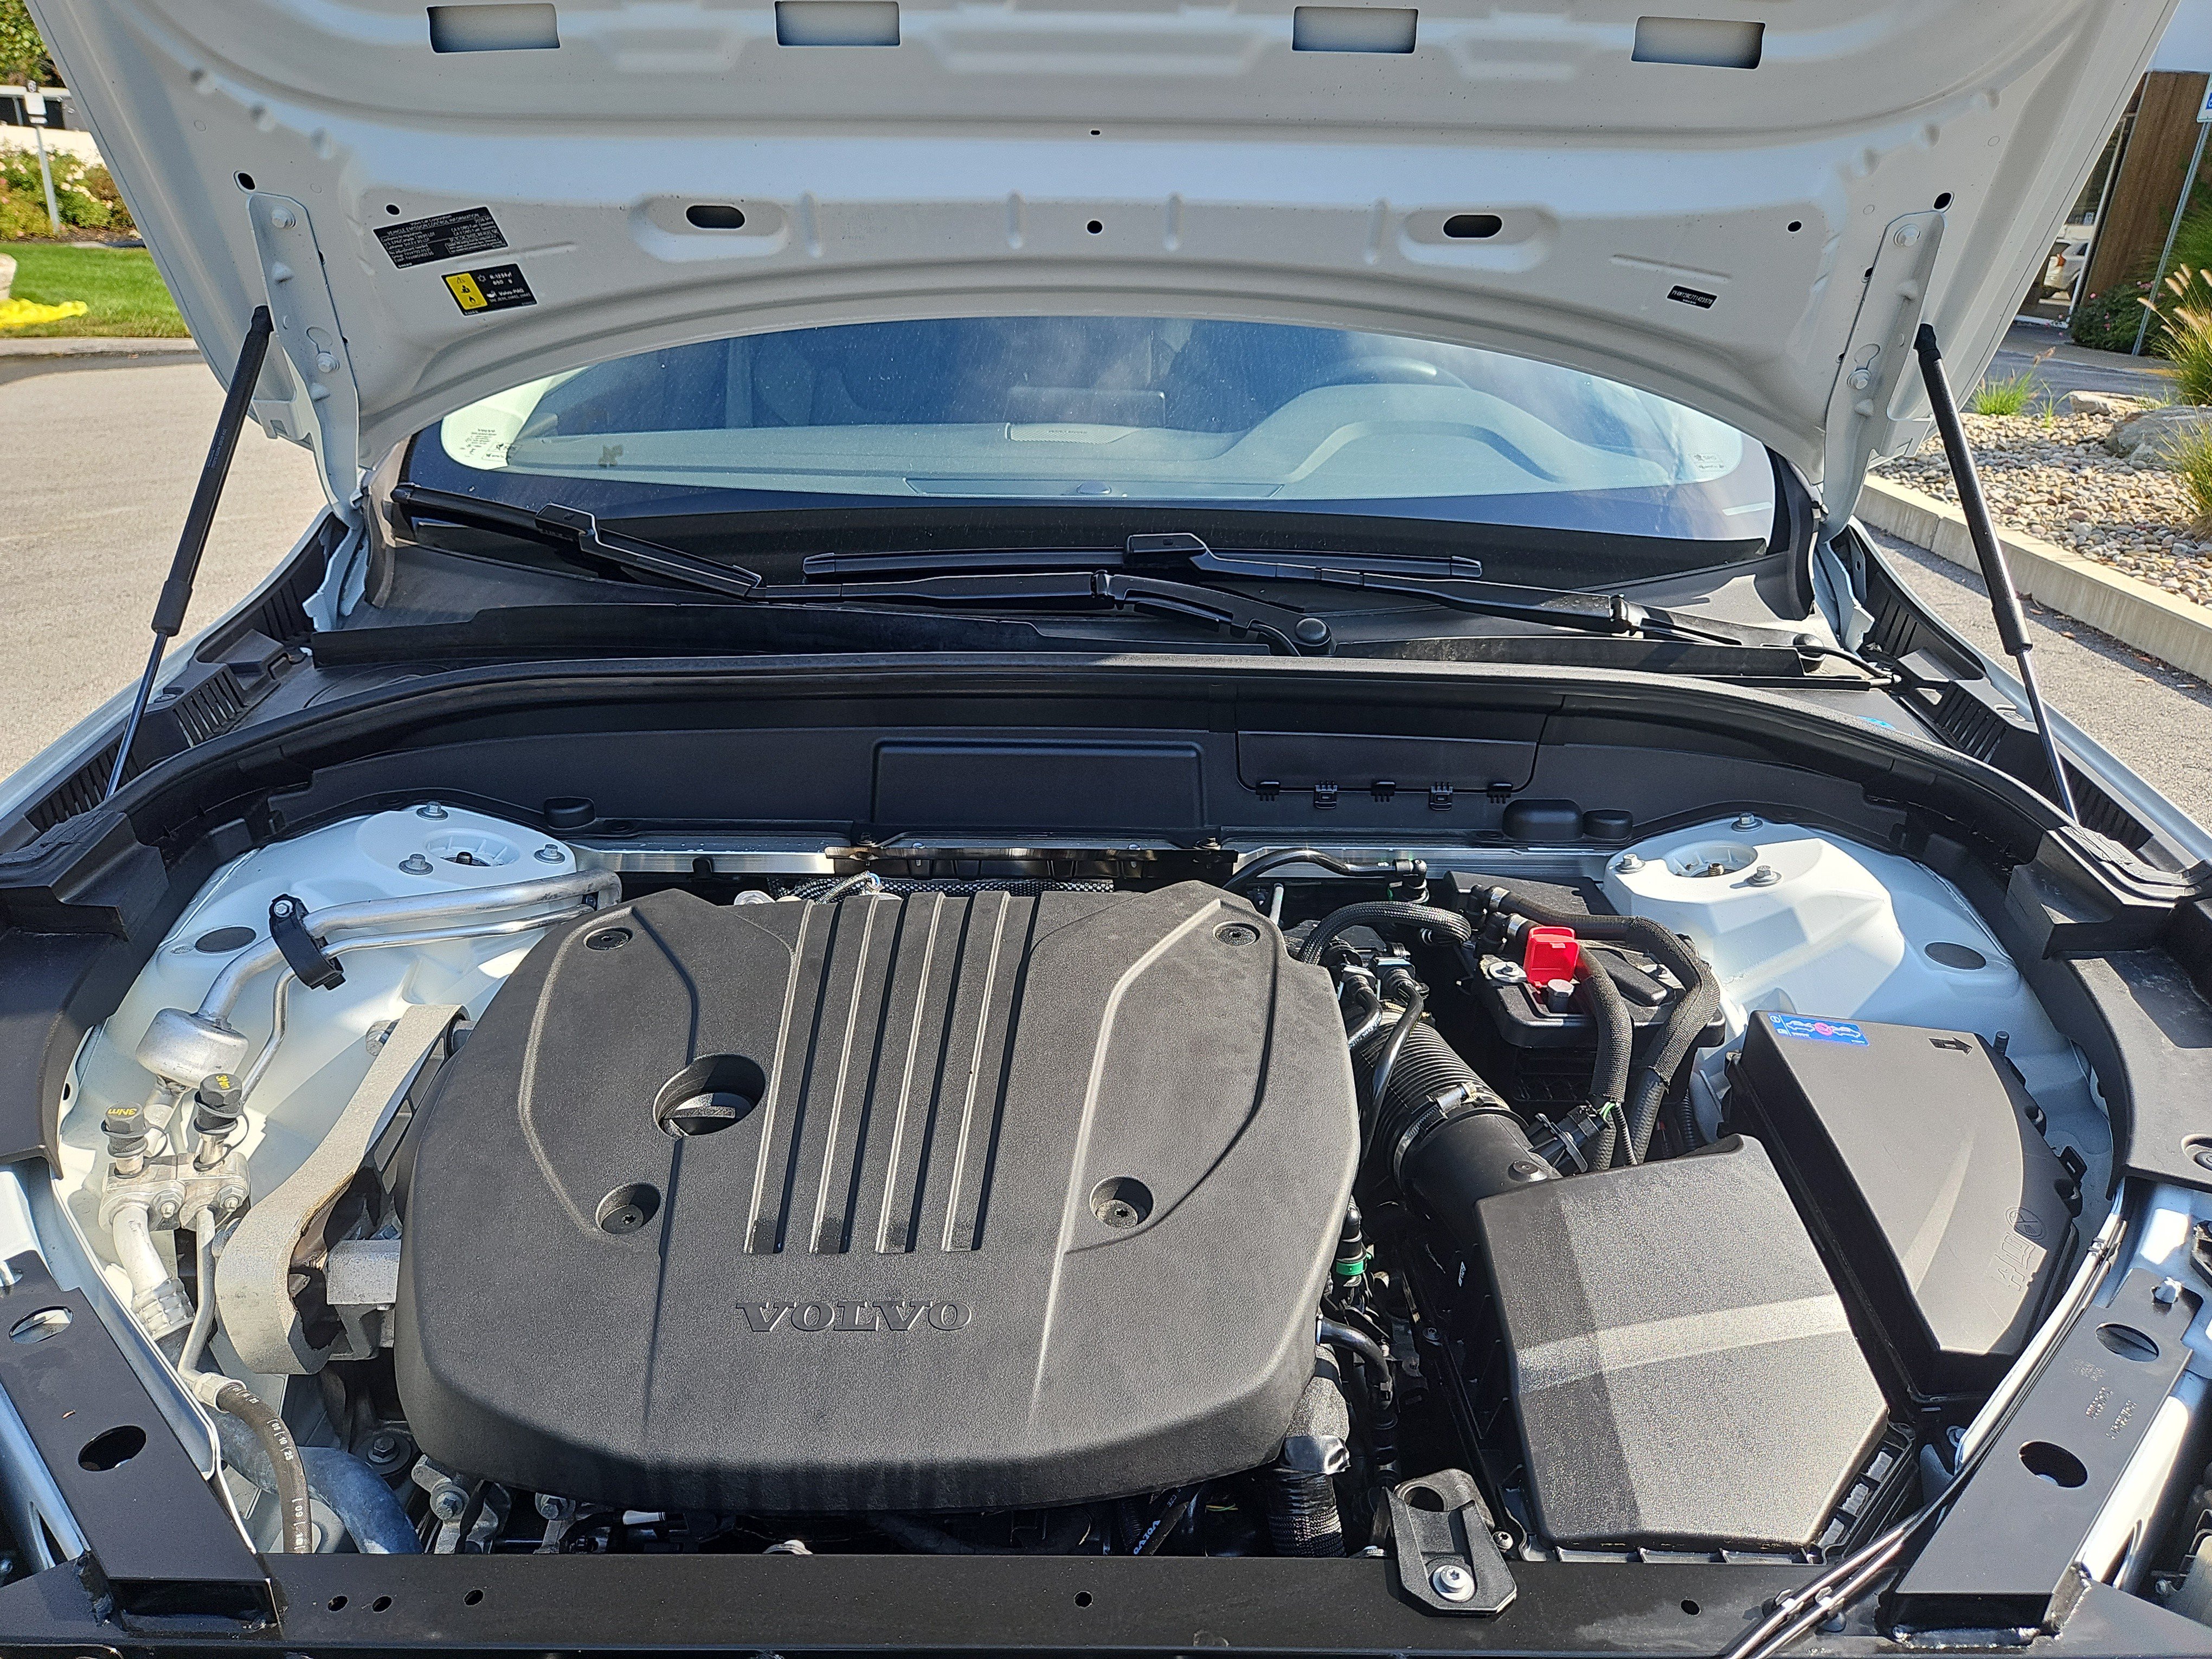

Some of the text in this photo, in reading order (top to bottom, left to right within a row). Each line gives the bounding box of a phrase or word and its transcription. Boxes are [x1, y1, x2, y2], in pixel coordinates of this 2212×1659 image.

[108, 1108, 137, 1116] 3Nm
[735, 1300, 973, 1333] VOLVO
[1134, 1520, 1161, 1555] VOLVO
